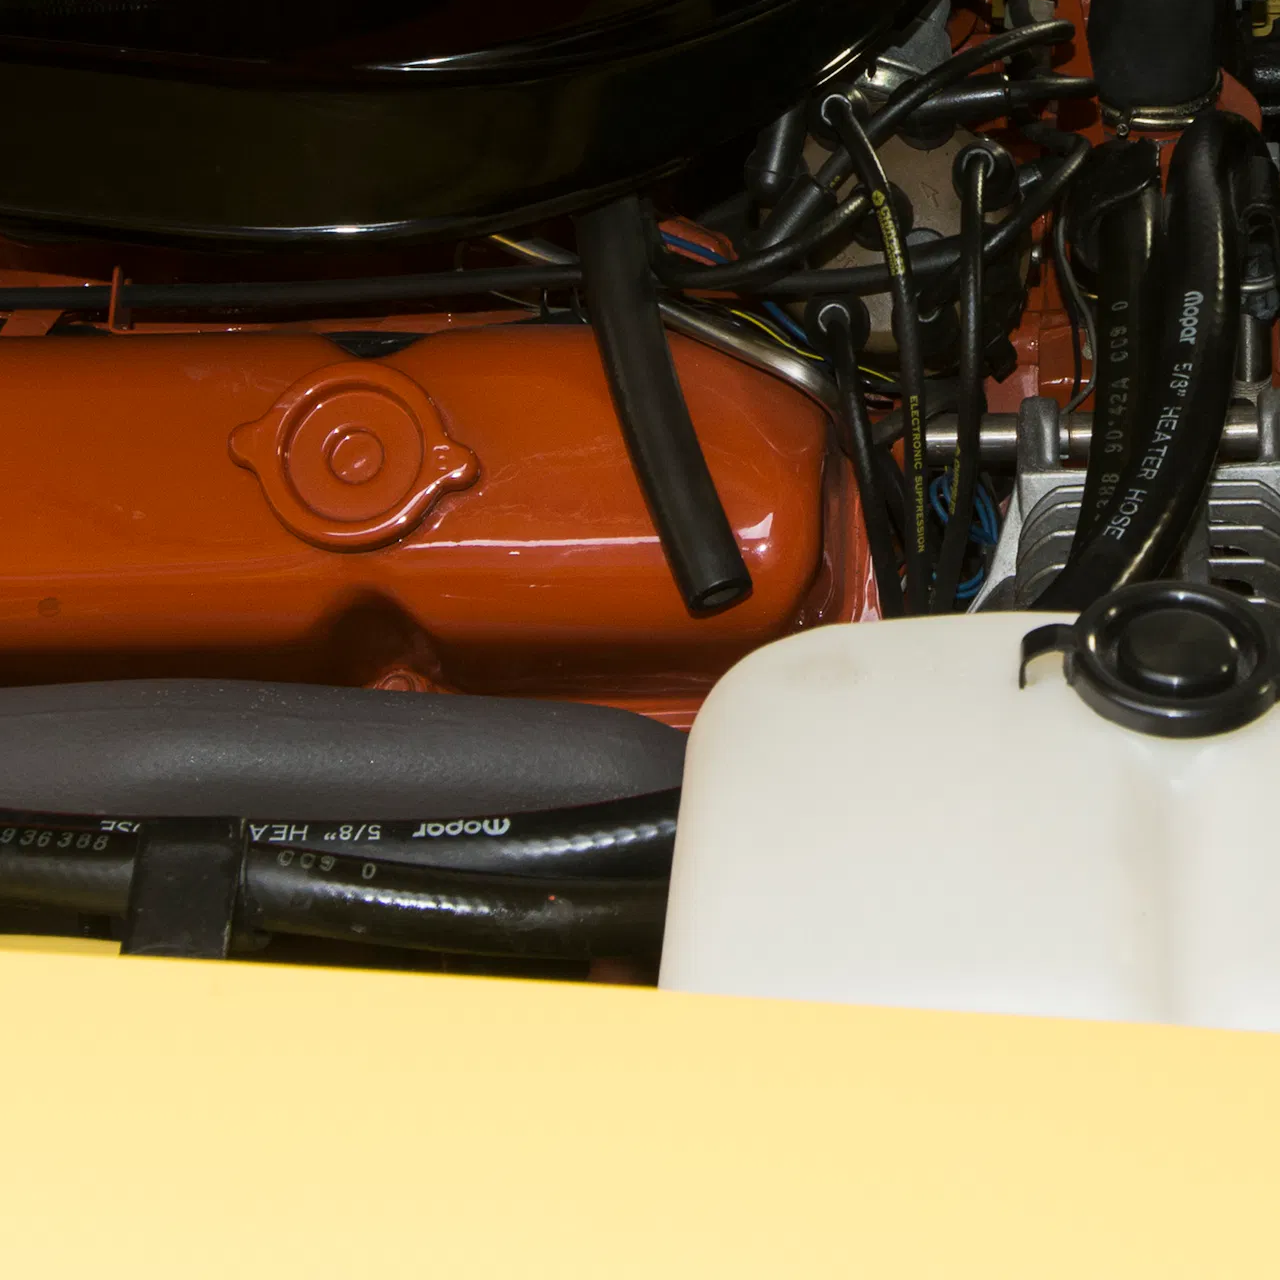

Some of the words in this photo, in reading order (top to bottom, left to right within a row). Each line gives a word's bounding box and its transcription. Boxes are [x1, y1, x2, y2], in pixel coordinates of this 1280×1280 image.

[908, 394, 923, 470] ELECTRONIC
[1141, 405, 1183, 480] HEATER
[914, 475, 926, 553] SUPPRESSION
[1103, 487, 1144, 541] HOSE
[249, 822, 309, 844] HEA
